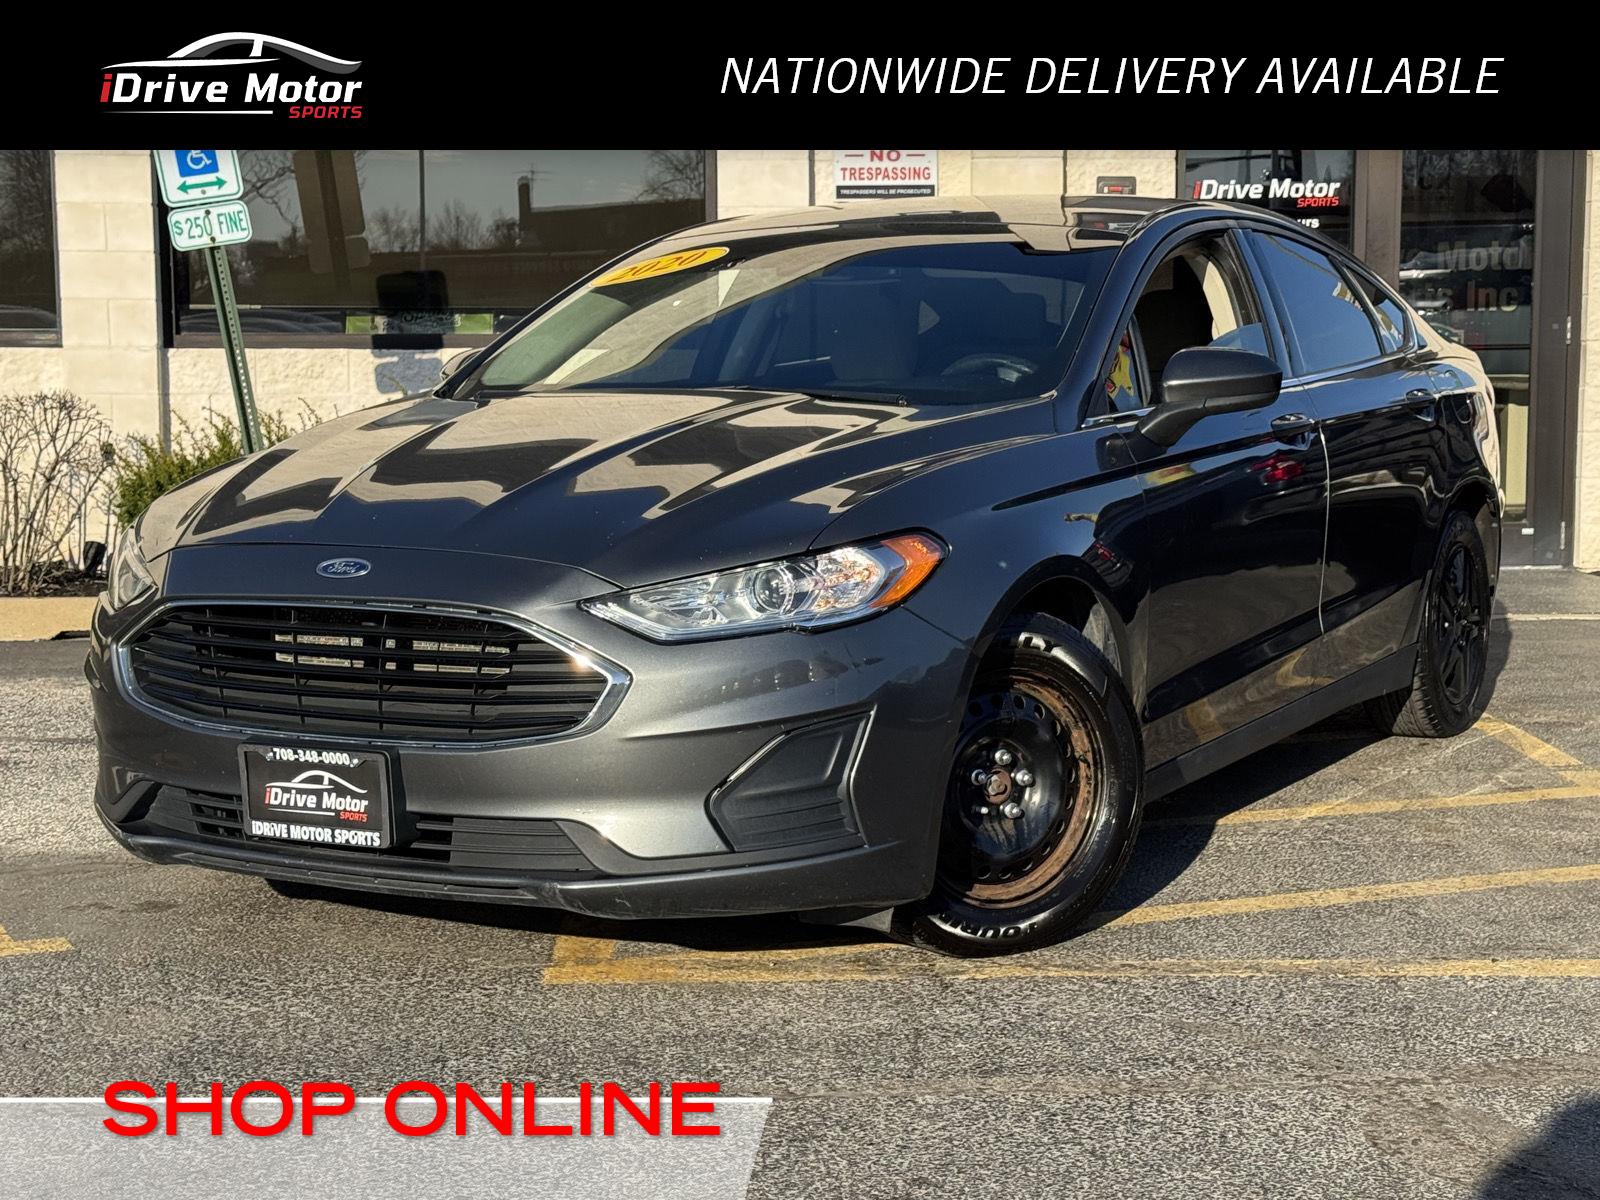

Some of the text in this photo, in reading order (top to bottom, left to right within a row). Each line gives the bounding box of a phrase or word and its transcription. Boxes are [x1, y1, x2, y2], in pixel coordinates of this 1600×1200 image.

[870, 150, 901, 162] NO
[841, 167, 931, 181] TRESPASSING
[1269, 178, 1341, 198] Motor
[1297, 197, 1339, 208] SPORTS
[173, 210, 247, 240] $250 FINE
[608, 251, 707, 283] 2020
[1466, 280, 1518, 312] Inc
[328, 562, 360, 573] Ford
[273, 748, 351, 765] 708-348-0000
[264, 787, 369, 812] iDrive Motor
[339, 811, 368, 822] SPORTS
[290, 825, 333, 843] MOTOR
[334, 830, 381, 846] SPORTS
